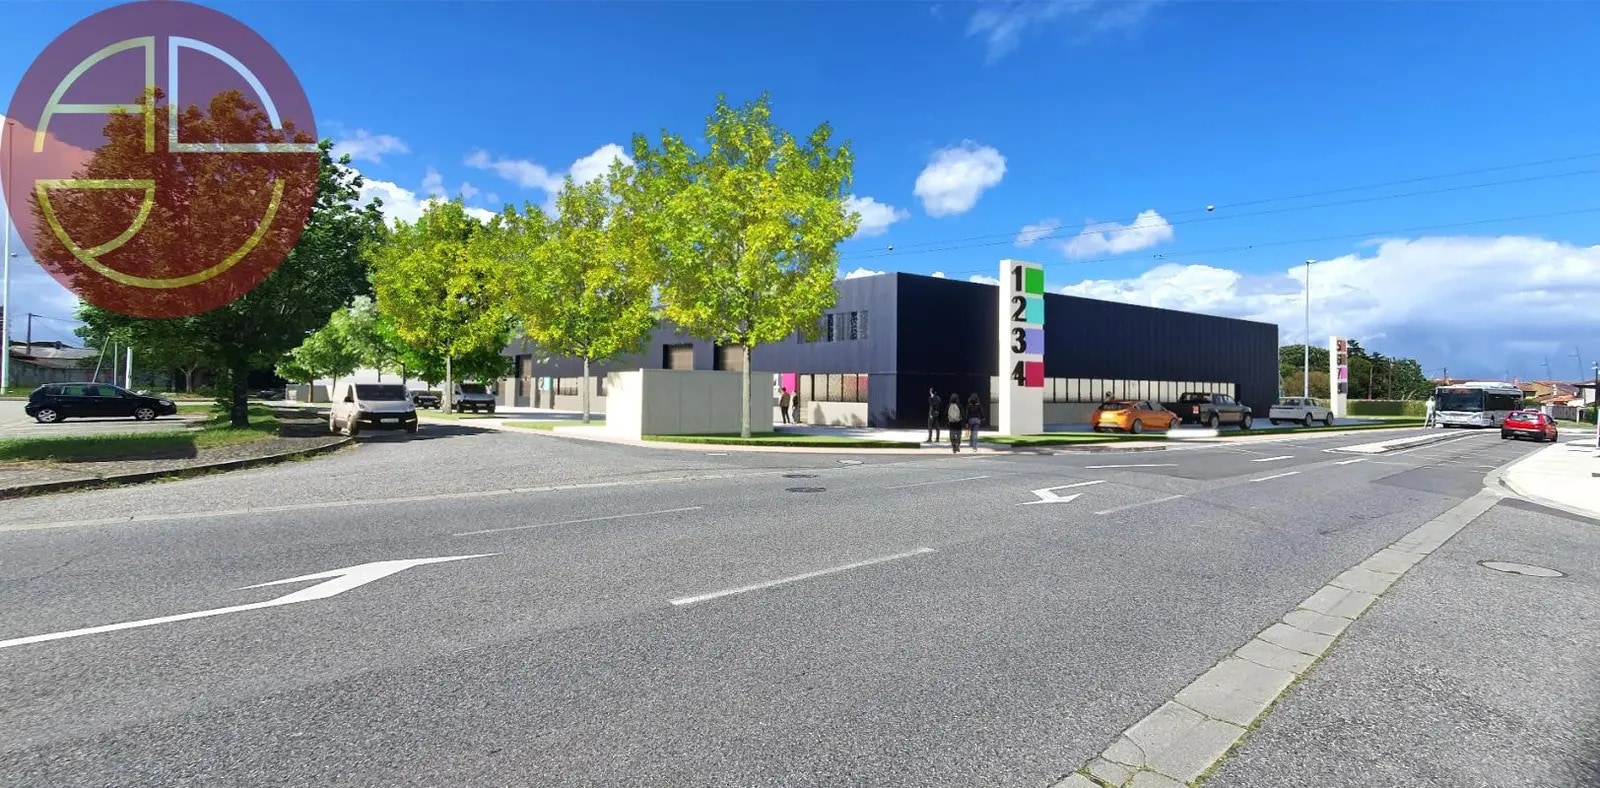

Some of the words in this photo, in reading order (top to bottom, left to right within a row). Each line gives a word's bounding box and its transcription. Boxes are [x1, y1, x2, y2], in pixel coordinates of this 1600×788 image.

[1011, 265, 1022, 292] 1
[1011, 295, 1027, 322] 2
[1011, 327, 1027, 354] 3
[1011, 360, 1027, 387] 4
